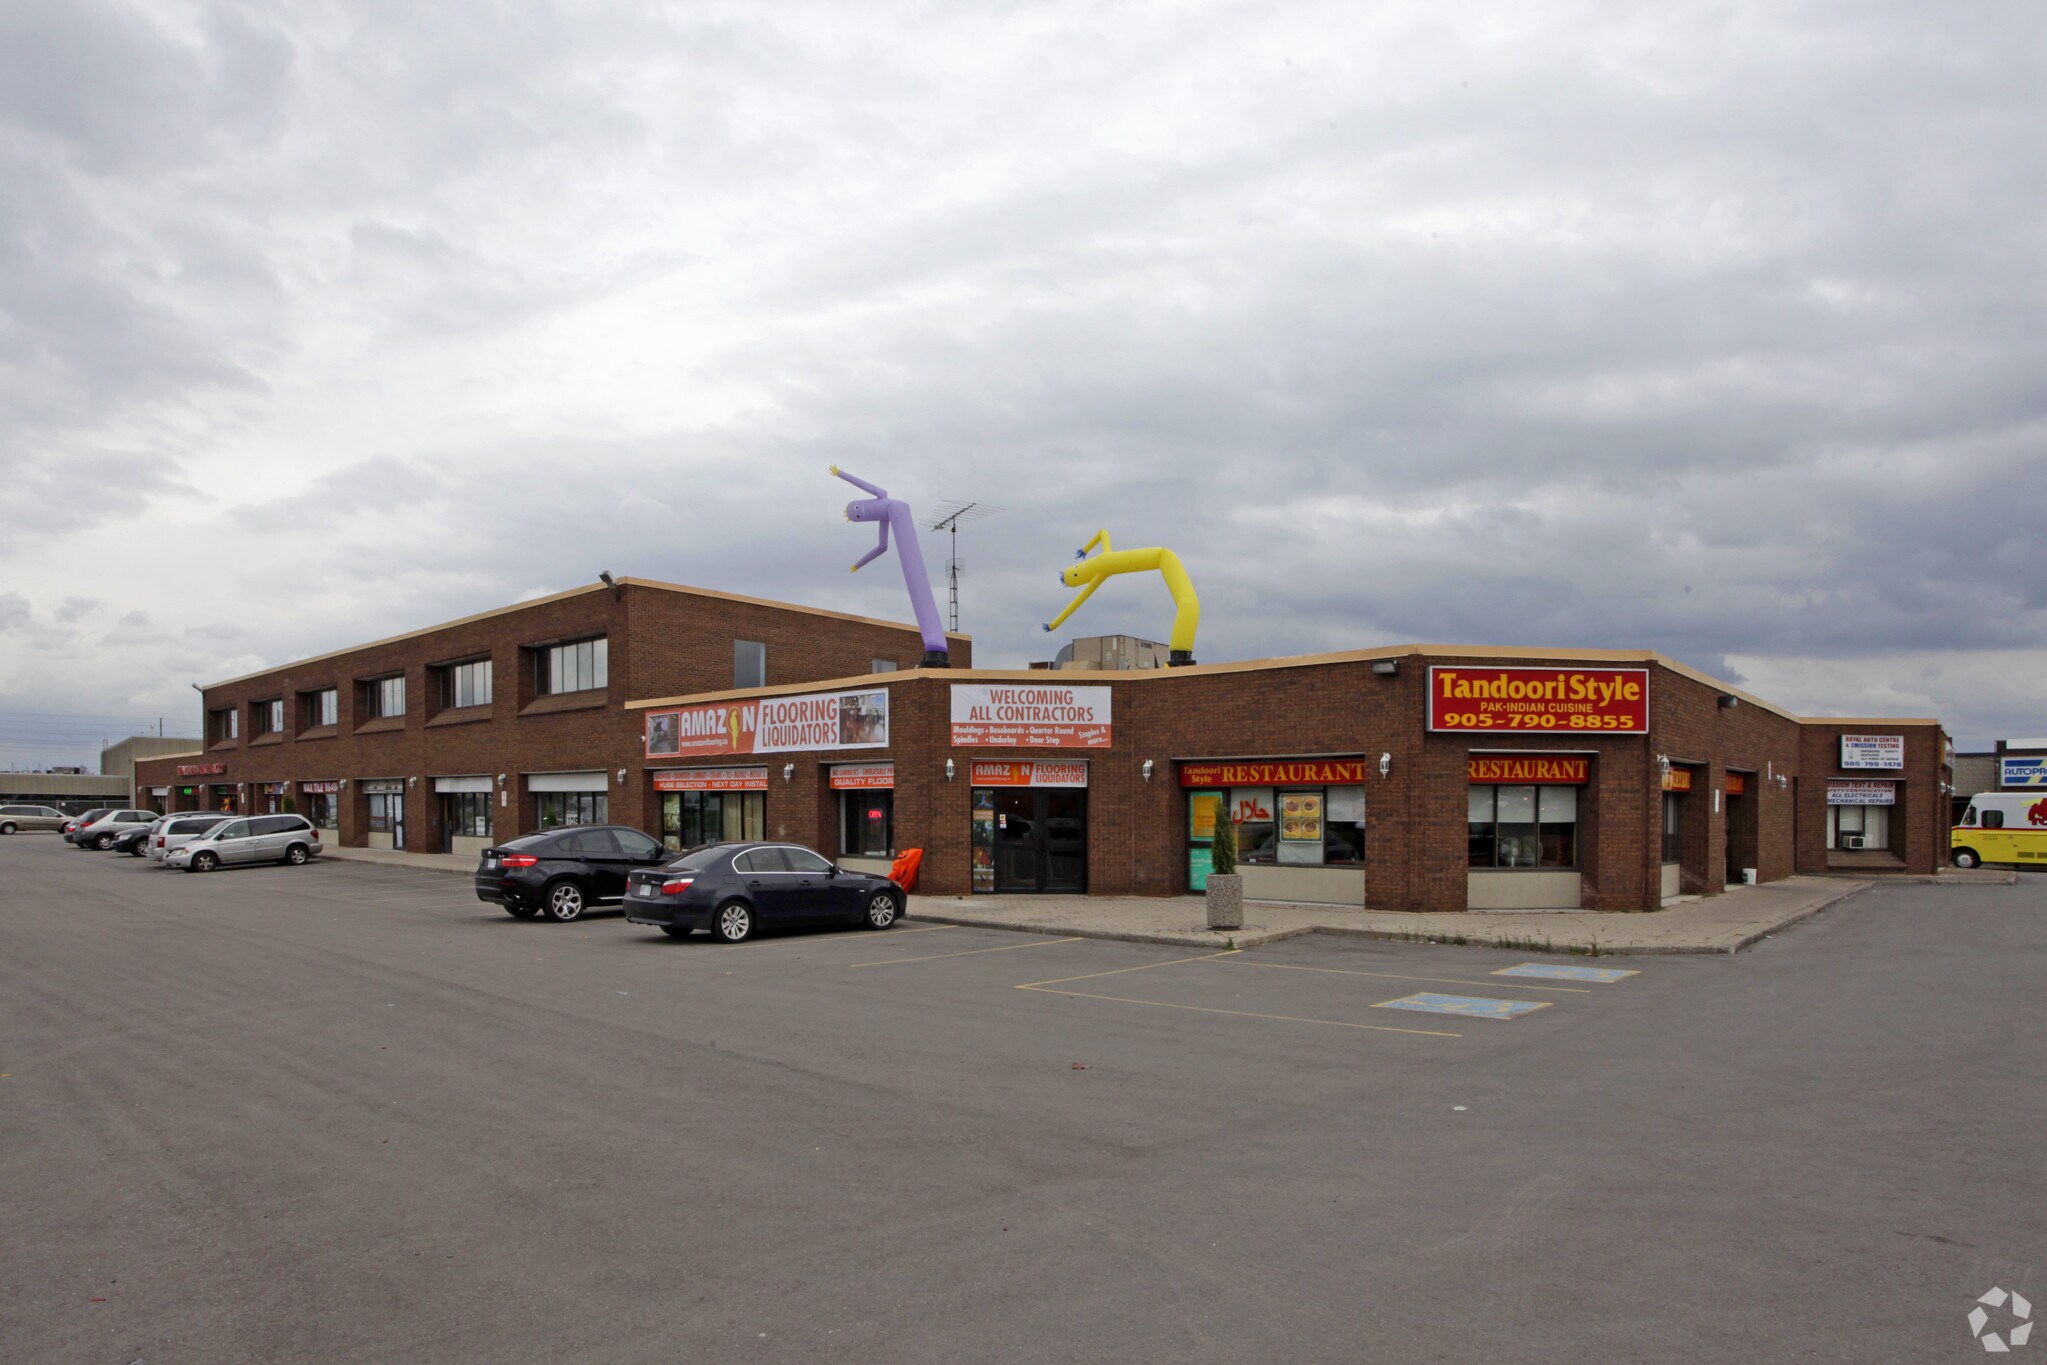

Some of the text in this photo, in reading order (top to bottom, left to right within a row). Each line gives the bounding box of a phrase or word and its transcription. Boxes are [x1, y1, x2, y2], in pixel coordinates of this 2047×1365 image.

[1438, 673, 1640, 707] Tandoori Style
[990, 689, 1074, 705] WELCOMING
[762, 698, 838, 726] FLOORING
[969, 705, 1094, 722] ALL CONTRACTORS
[1480, 702, 1593, 713] PAK-INDIAN CUISINE
[681, 705, 755, 737] AMAZON
[1444, 713, 1634, 728] 905-790-8855
[762, 721, 838, 748] LIQUIDATORS
[953, 726, 1074, 736] Mouldings Baseboards Quarter Round
[1078, 726, 1107, 739] Staples &
[953, 735, 1060, 745] Spindles Underlay Door Stop
[1036, 764, 1085, 774] FLOORING
[1183, 766, 1221, 775] Tandoori
[1221, 762, 1365, 783] RESTAURANT
[1468, 760, 1588, 778] RESTAURANT
[2004, 767, 2047, 776] AUTOPR
[712, 780, 729, 788] NEXT
[834, 777, 894, 786] QUALITY FLOOR
[1036, 773, 1085, 783] LIQUIDATORS
[1190, 774, 1212, 784] Style
[1231, 797, 1270, 826] حلال
